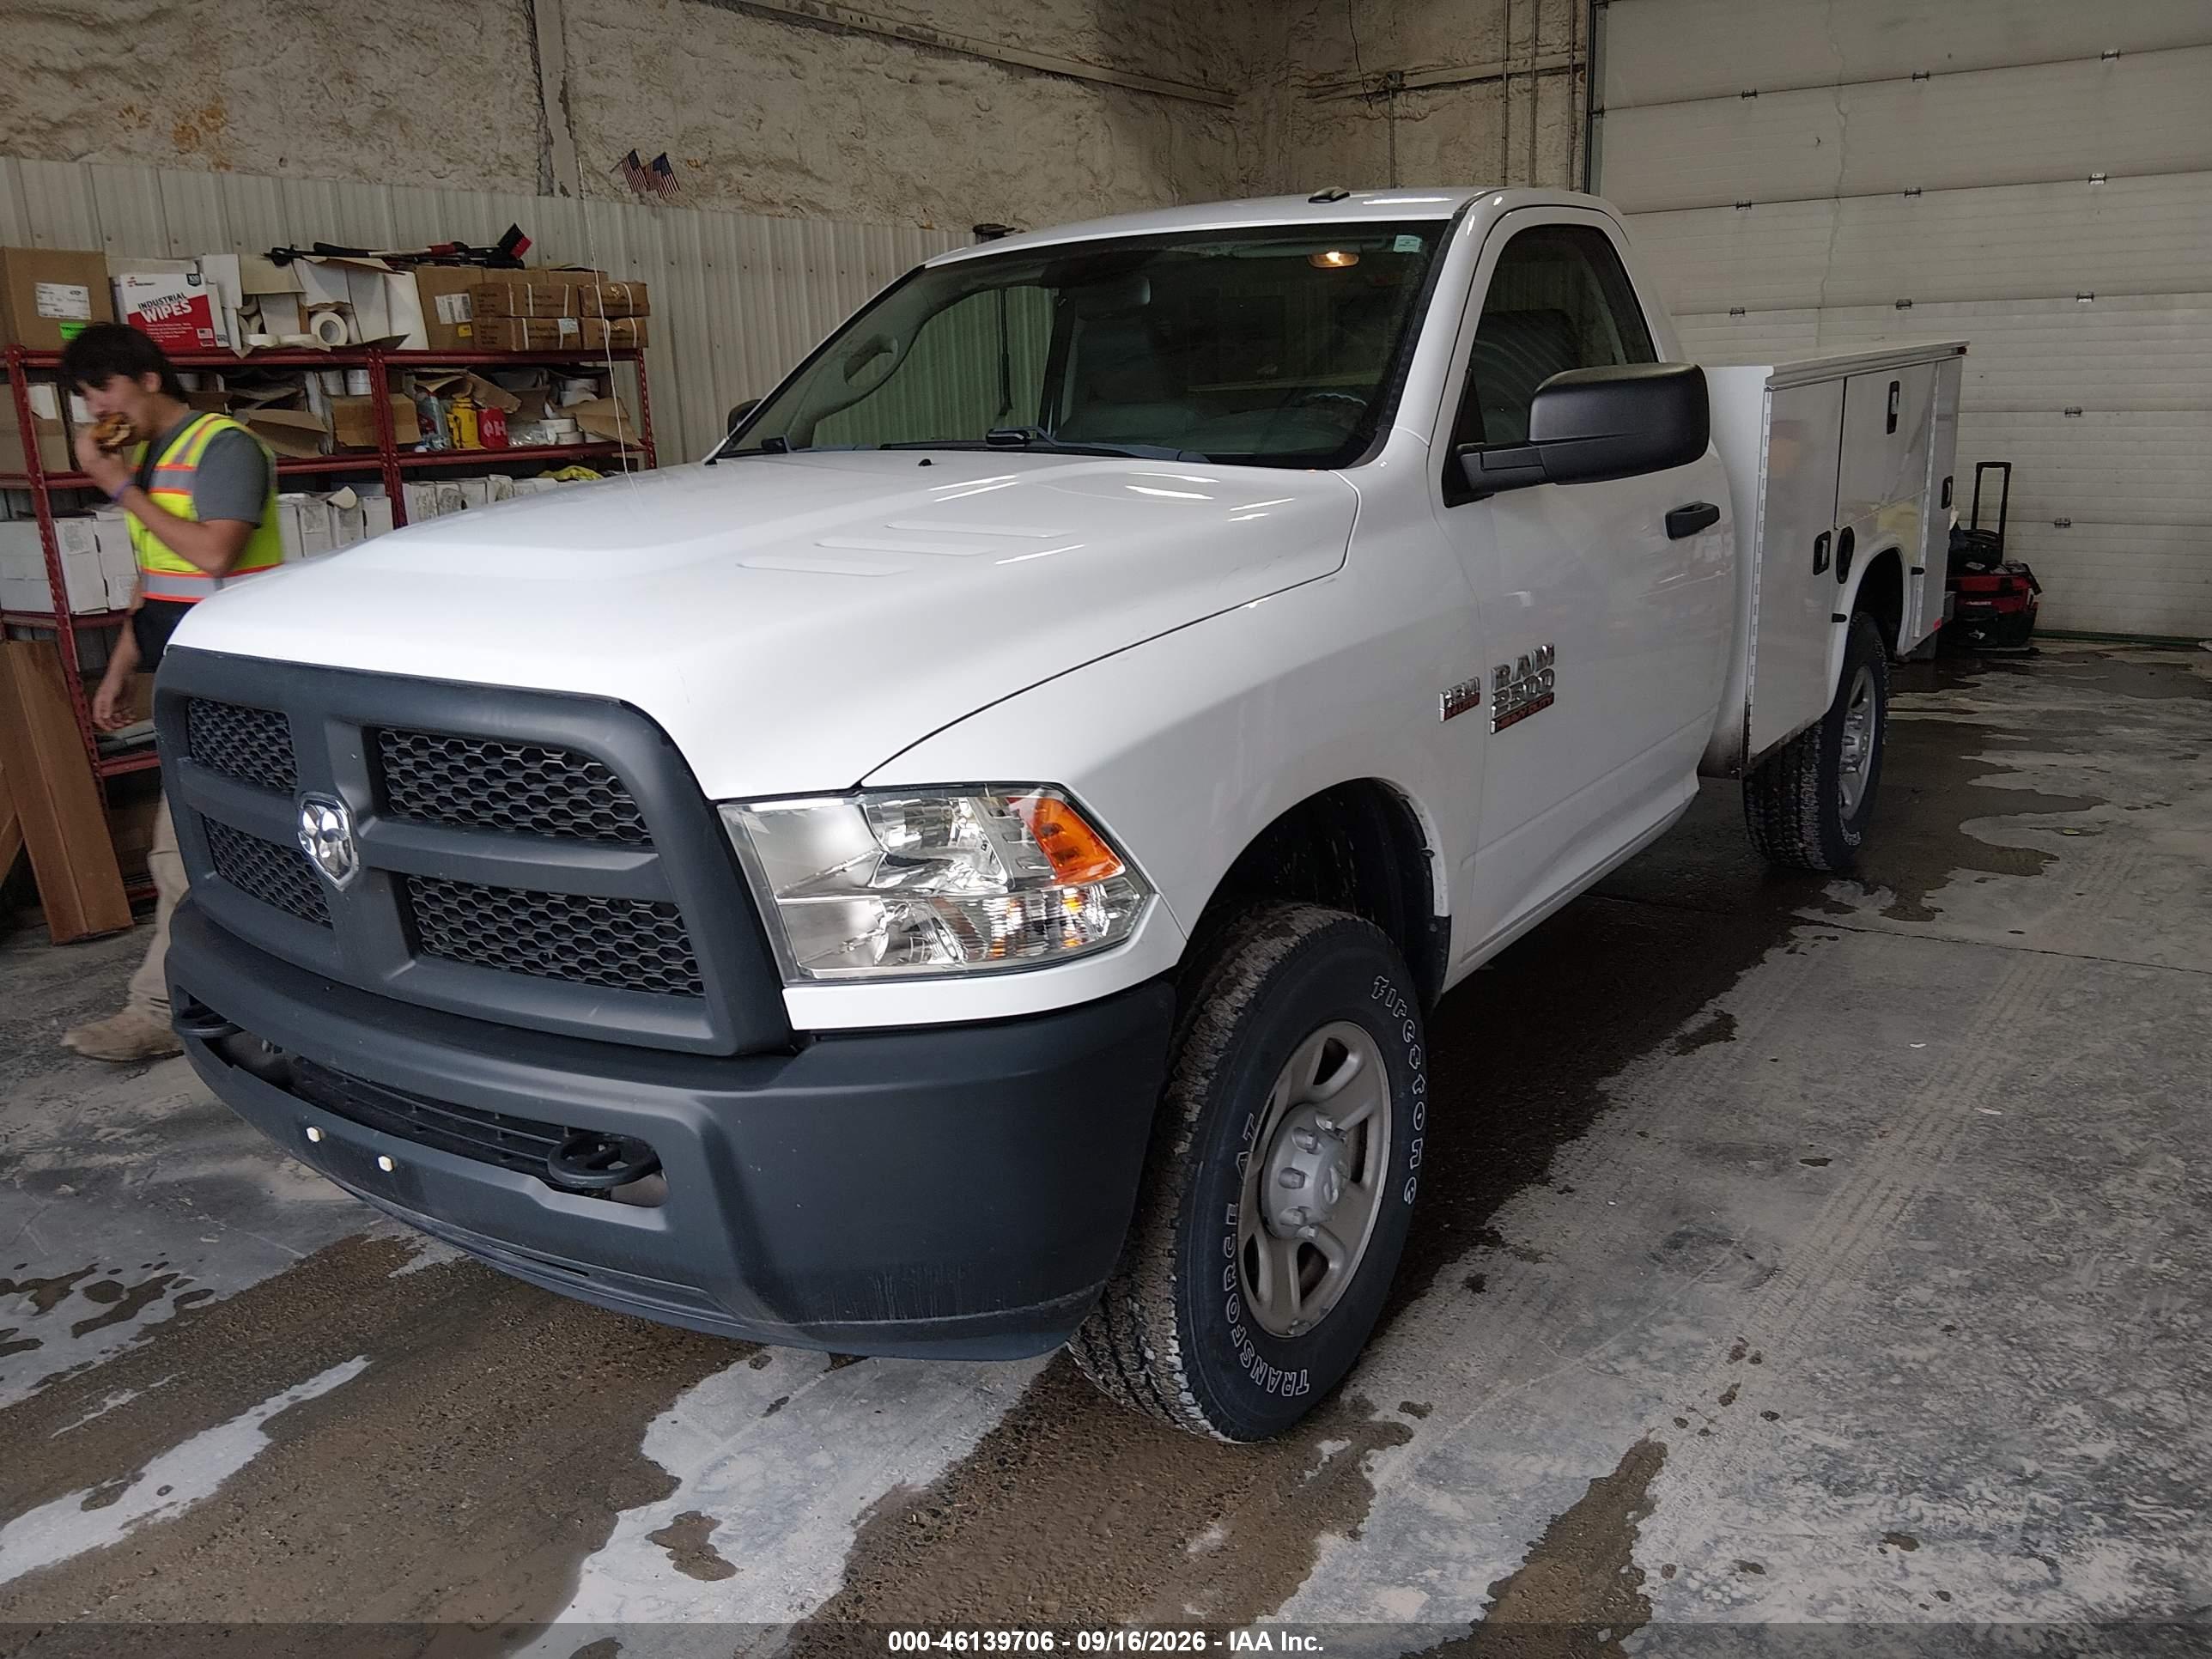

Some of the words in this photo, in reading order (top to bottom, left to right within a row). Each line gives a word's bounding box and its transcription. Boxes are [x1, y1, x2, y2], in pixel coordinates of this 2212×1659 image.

[137, 292, 187, 309] INDUSTRIAL
[140, 300, 193, 323] WIPES
[1491, 644, 1554, 692] RAM
[1491, 668, 1554, 718] 2500
